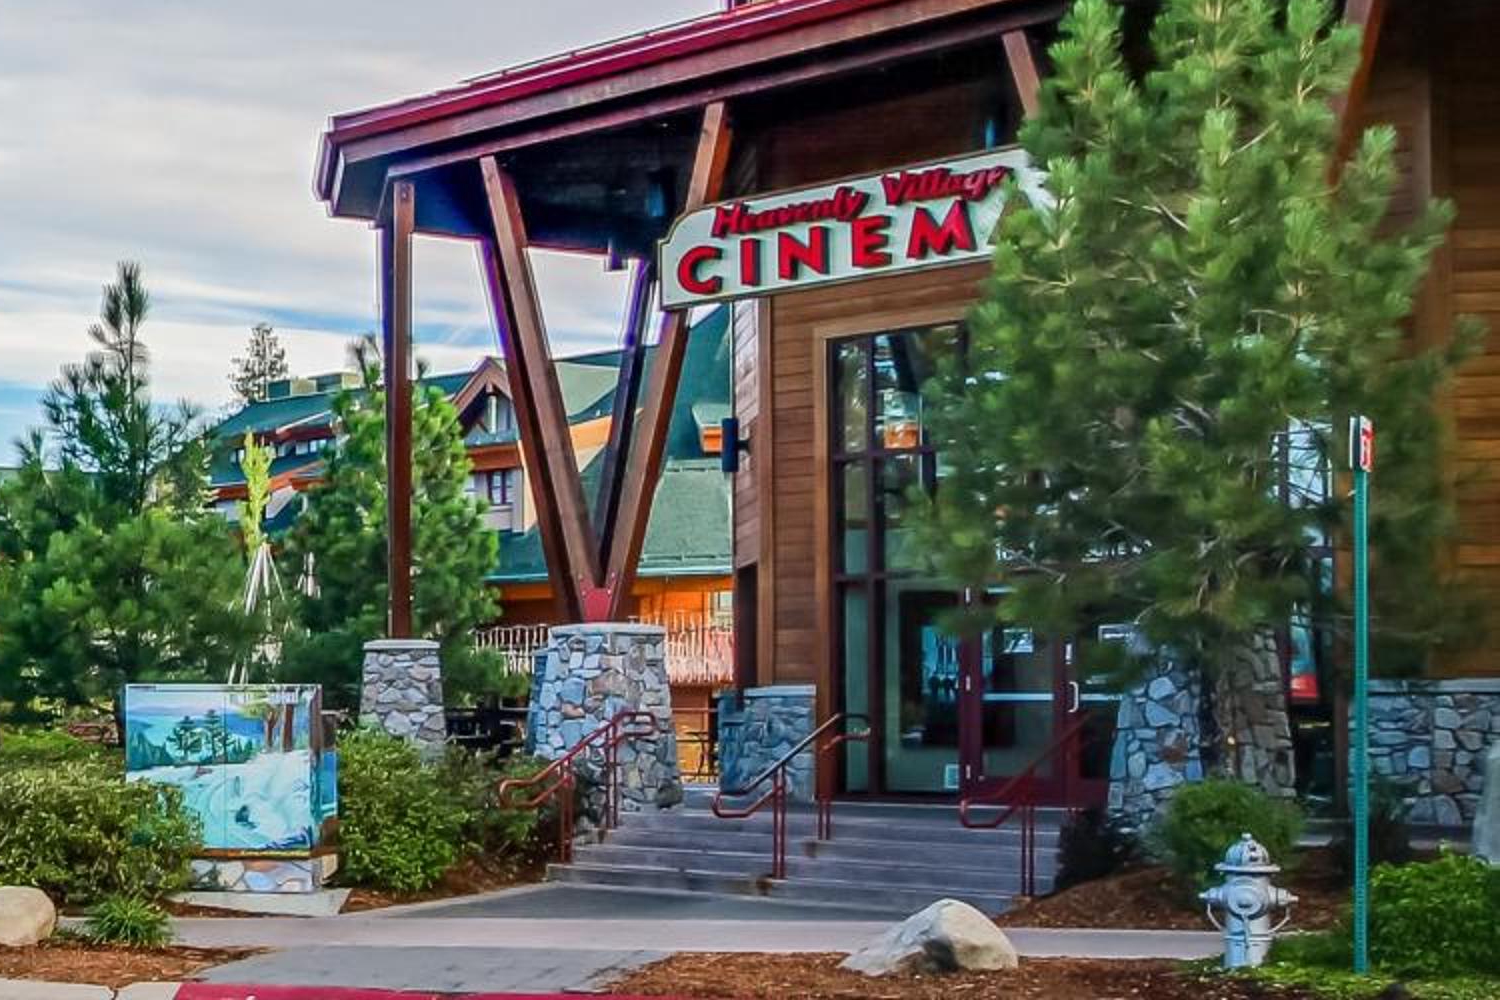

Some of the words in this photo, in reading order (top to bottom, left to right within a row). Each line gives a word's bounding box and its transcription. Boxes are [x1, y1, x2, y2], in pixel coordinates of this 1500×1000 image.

[677, 189, 1028, 295] CINEM
[712, 186, 870, 239] Heavenly
[881, 166, 1012, 206] Village
